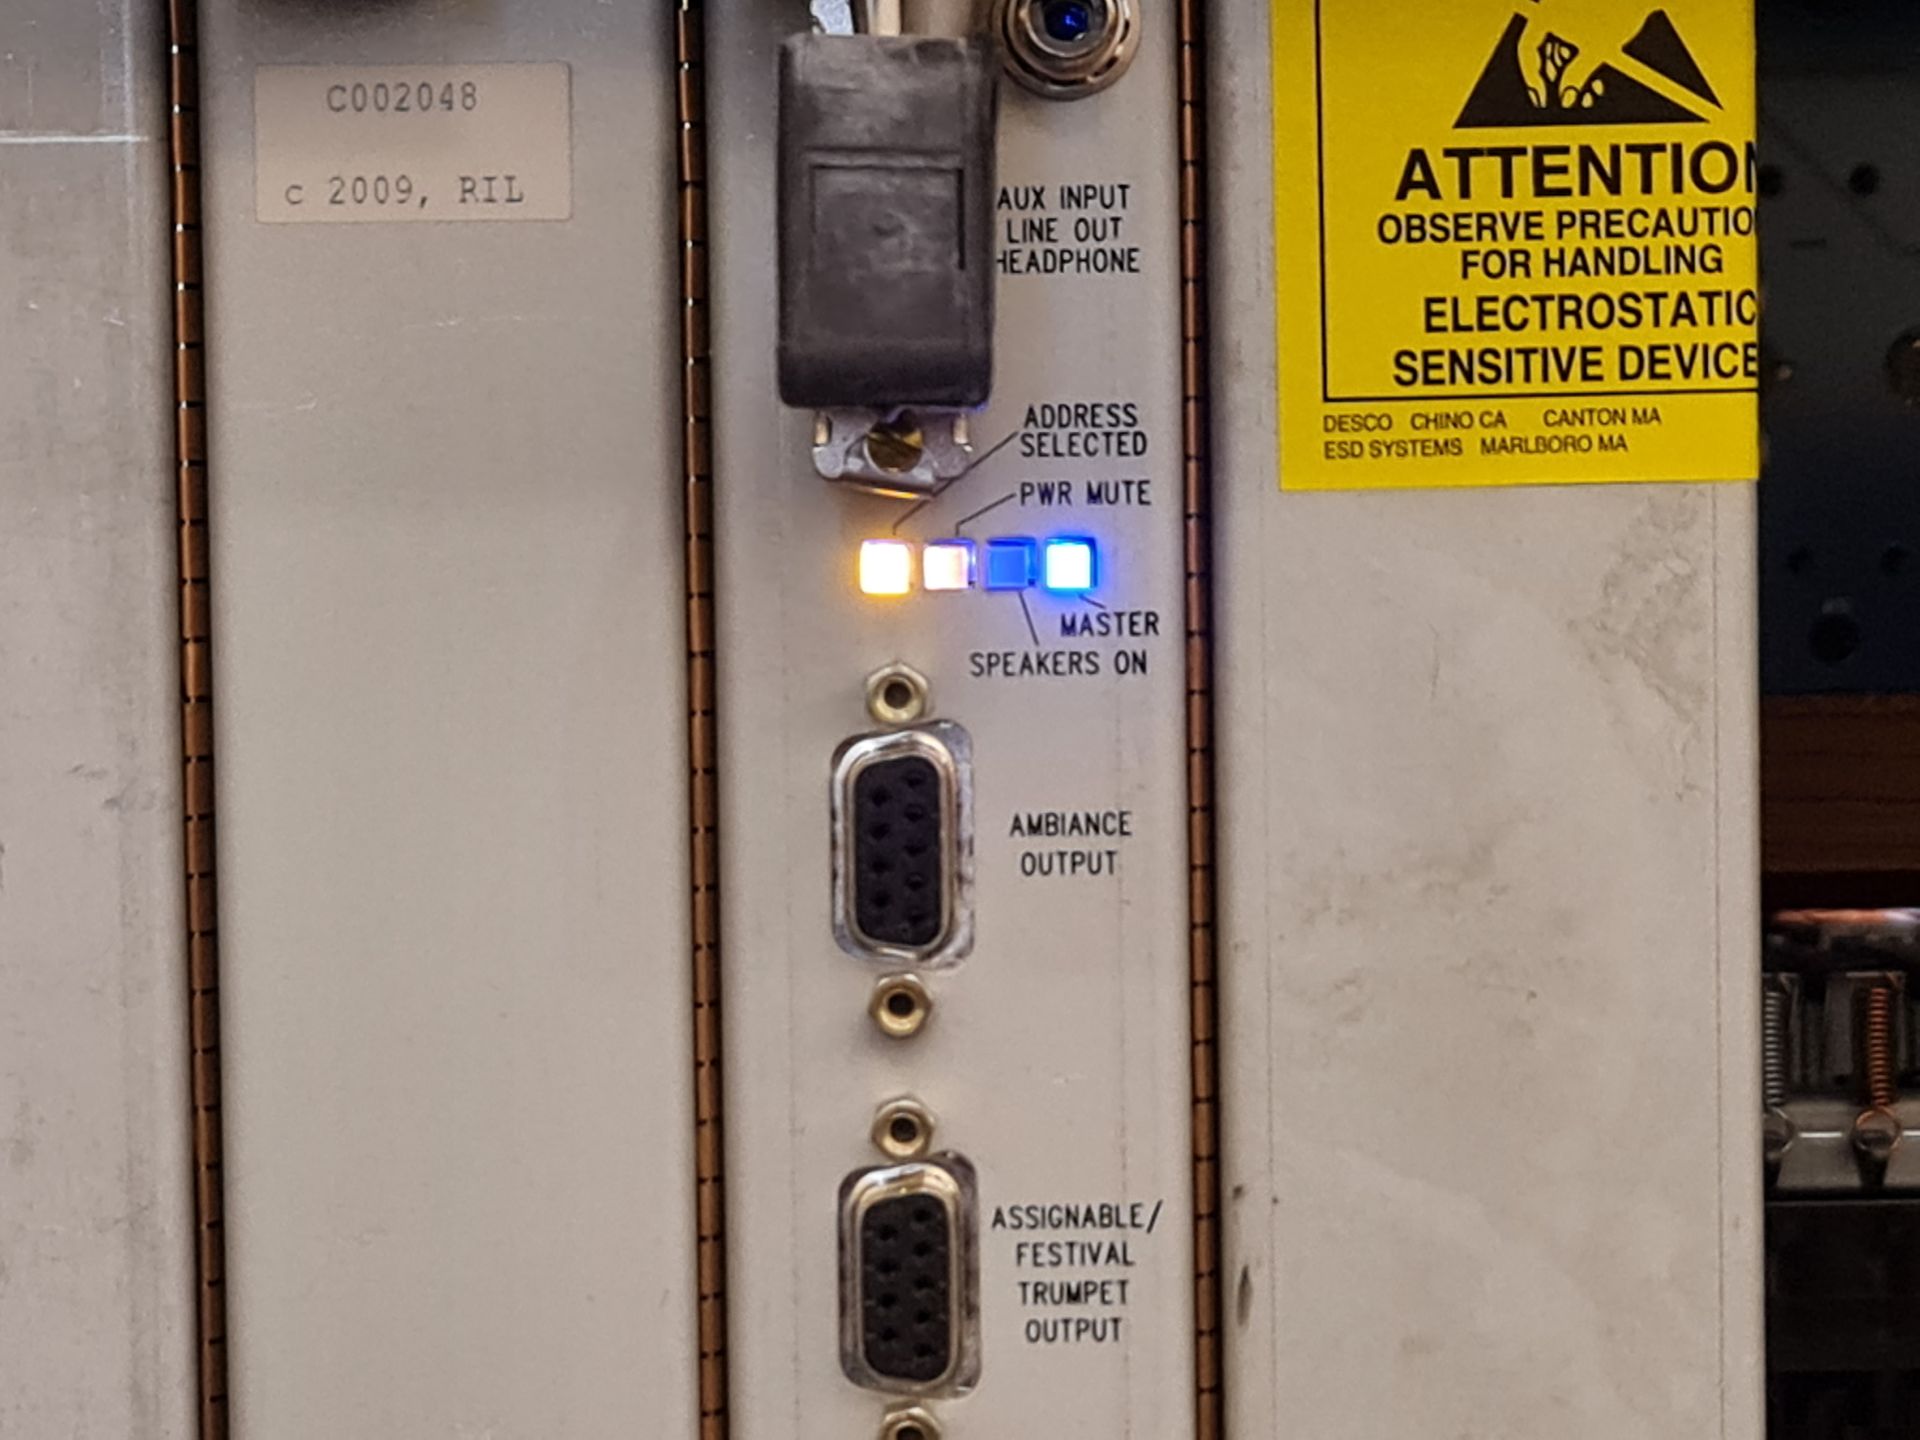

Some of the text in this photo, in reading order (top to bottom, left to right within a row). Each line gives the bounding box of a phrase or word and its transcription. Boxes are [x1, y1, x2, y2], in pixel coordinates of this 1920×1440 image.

[326, 81, 477, 112] C002048
[1394, 141, 1757, 200] ATTENTIO
[284, 174, 524, 209] c 2009, RIL
[997, 184, 1130, 210] AUX INPUT
[1006, 216, 1122, 243] LINE OUT
[1377, 206, 1757, 245] OBSERVE PRECAUTIO
[997, 248, 1140, 273] HEADPHONE
[1461, 244, 1723, 279] FOR HANDLING
[1424, 289, 1758, 333] ELECTROSTATIC
[1393, 342, 1758, 387] SENSITIVE DEVICE
[1023, 403, 1138, 429] ADDRESS
[1323, 407, 1662, 433] DESCO CHINO CA CANTON MA
[1020, 431, 1148, 457] SELECTED
[1324, 433, 1628, 460] ESD SYSTEMS MARLBORO MA
[1020, 480, 1151, 505] PWR MUTE
[1060, 611, 1159, 637] MASTER
[970, 650, 1147, 677] SPEAKERS ON
[1009, 811, 1132, 837] AMBIANCE
[1021, 850, 1118, 876] OUTPUT
[992, 1199, 1163, 1234] ASSIGNABLE/
[1016, 1241, 1135, 1267] FESTIVAL
[1018, 1279, 1129, 1305] TRUMPET
[1025, 1317, 1122, 1343] OUTPUT
